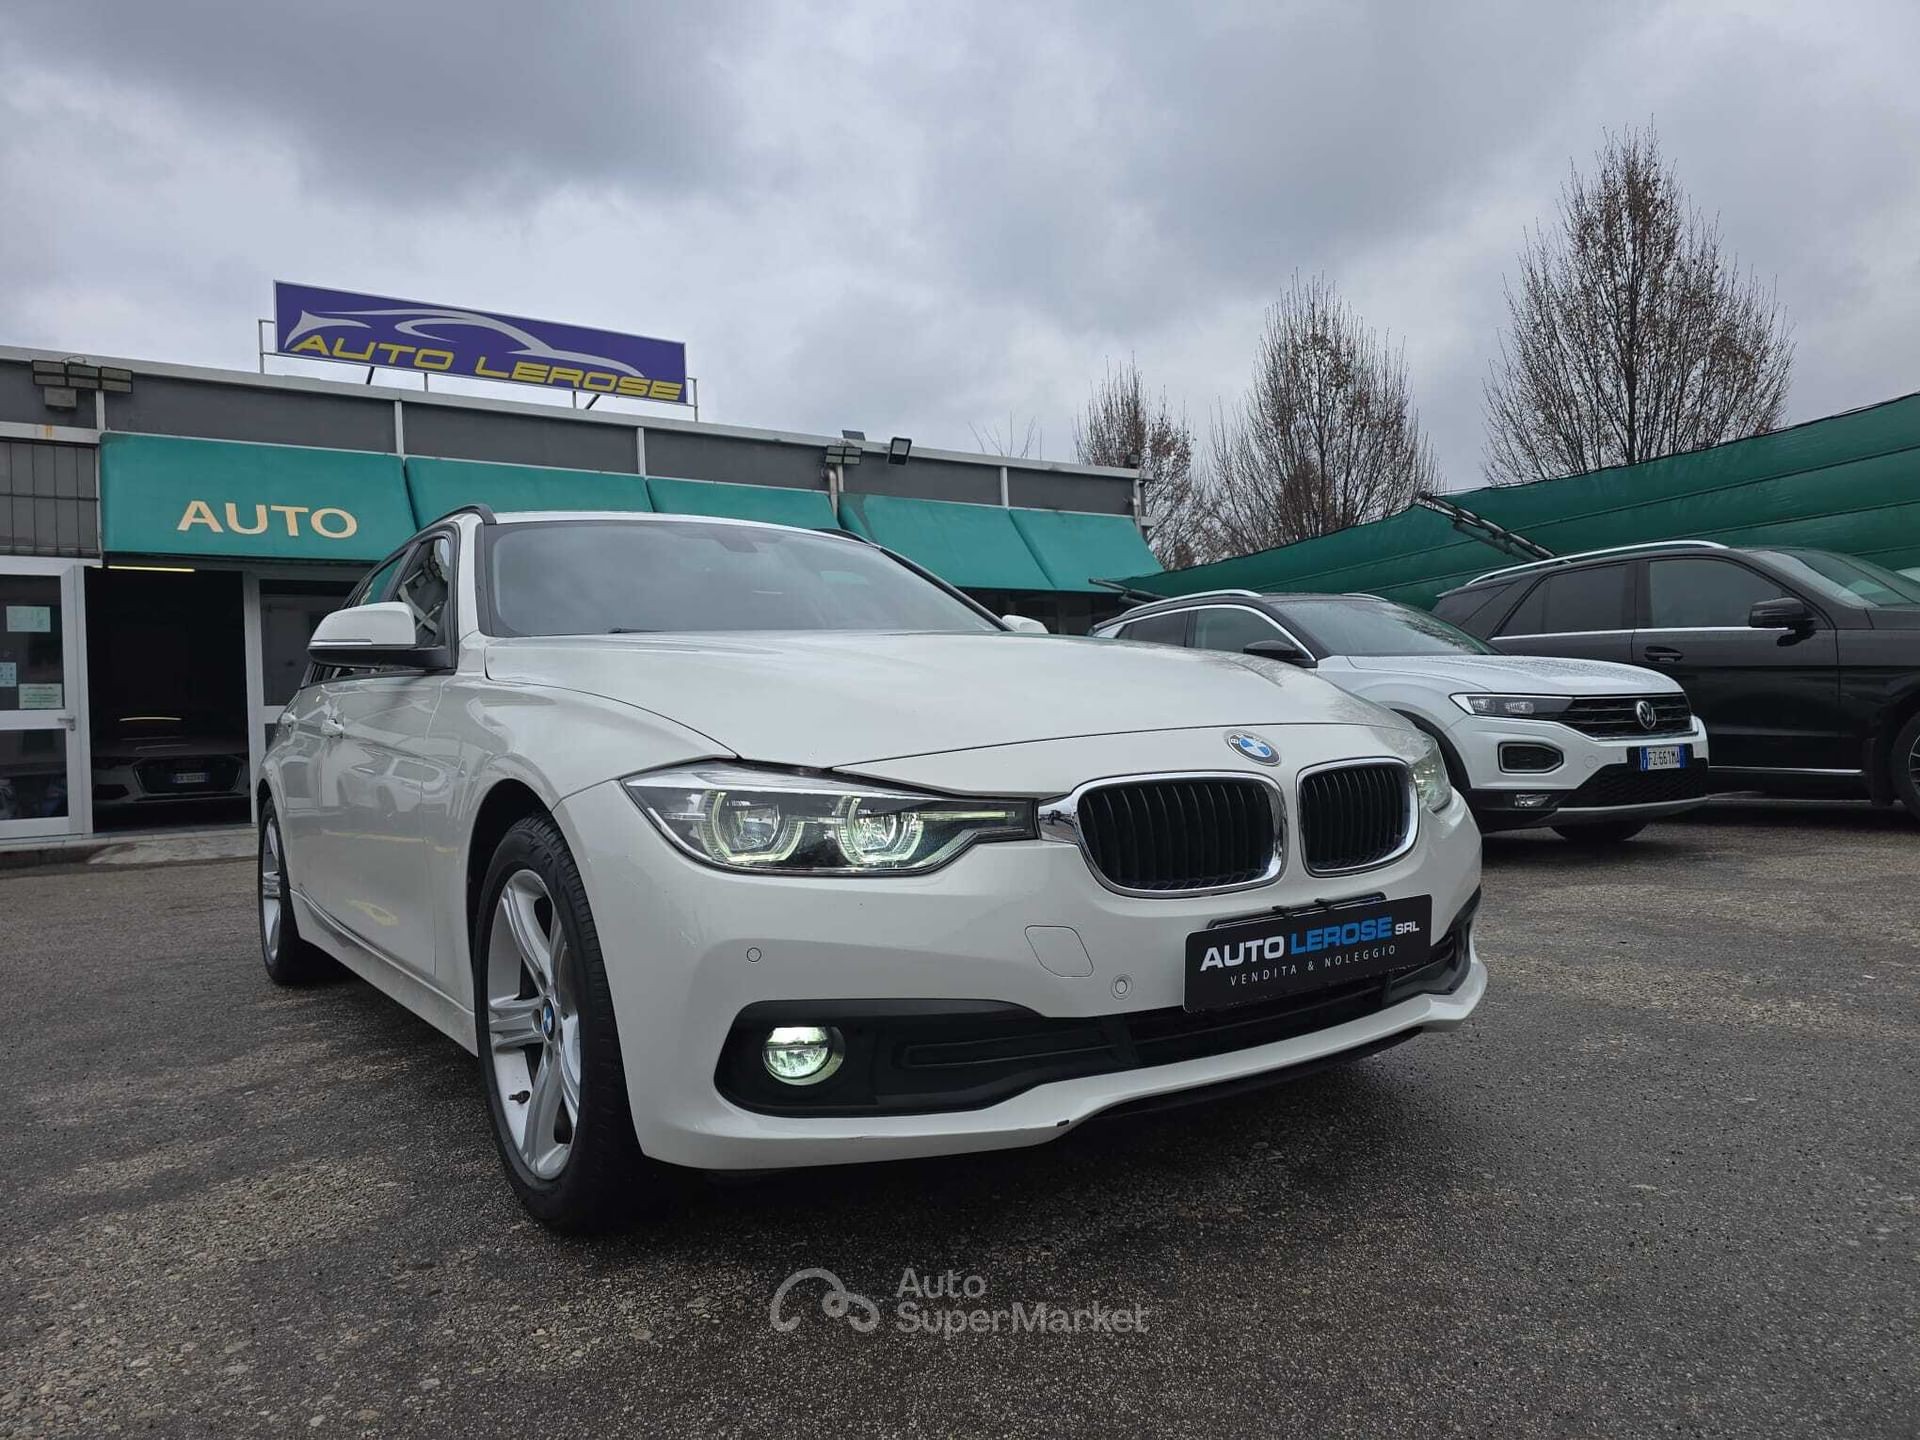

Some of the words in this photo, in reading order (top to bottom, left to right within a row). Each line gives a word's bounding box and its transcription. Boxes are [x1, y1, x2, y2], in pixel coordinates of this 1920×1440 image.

[292, 334, 455, 371] AUTO
[474, 357, 684, 401] LEROSE
[177, 500, 358, 539] AUTO
[1200, 935, 1285, 972] AUTO
[1290, 916, 1393, 955] LEROSE
[1395, 920, 1420, 935] SRL
[1230, 964, 1297, 986] VENDITA
[1307, 960, 1315, 972] &
[1324, 944, 1396, 968] NOLEGGIO
